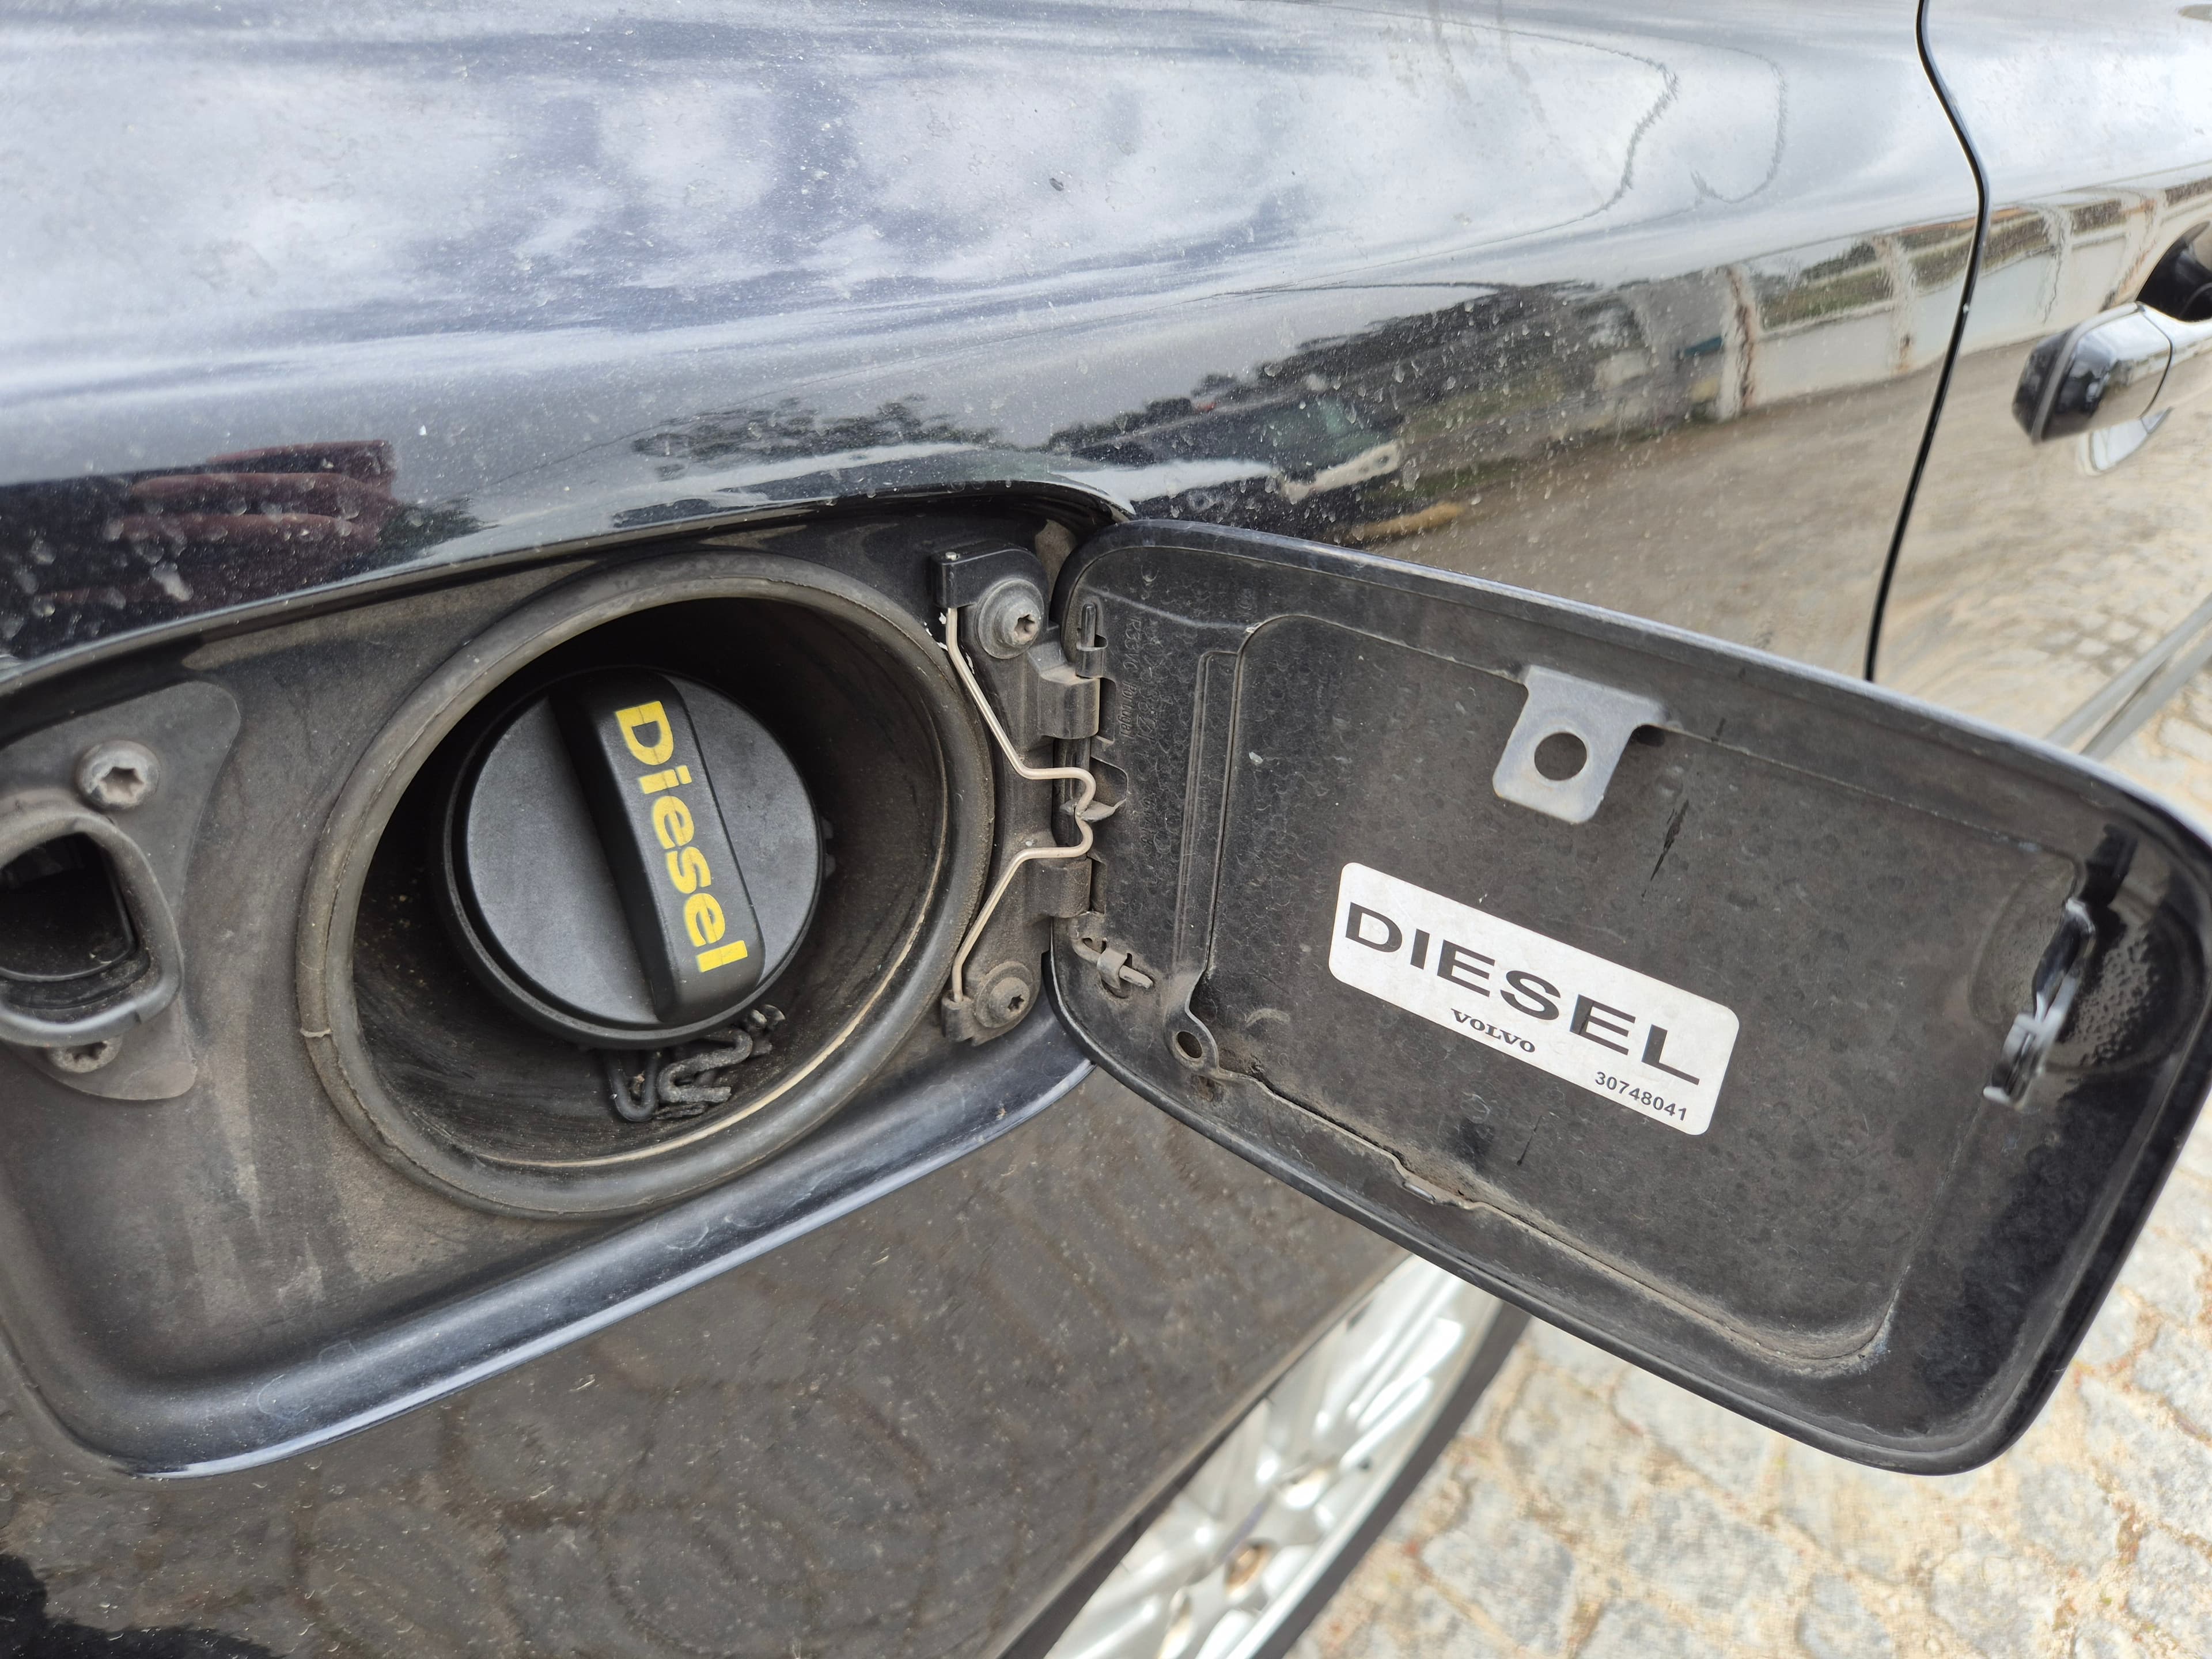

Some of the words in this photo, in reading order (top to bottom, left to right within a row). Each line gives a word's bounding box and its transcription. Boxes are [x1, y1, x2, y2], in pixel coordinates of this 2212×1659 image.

[615, 700, 749, 973] Diesel
[1344, 902, 1700, 1086] DIESEL
[1450, 1007, 1536, 1054] VOLVO
[1594, 1070, 1688, 1122] 30748041
